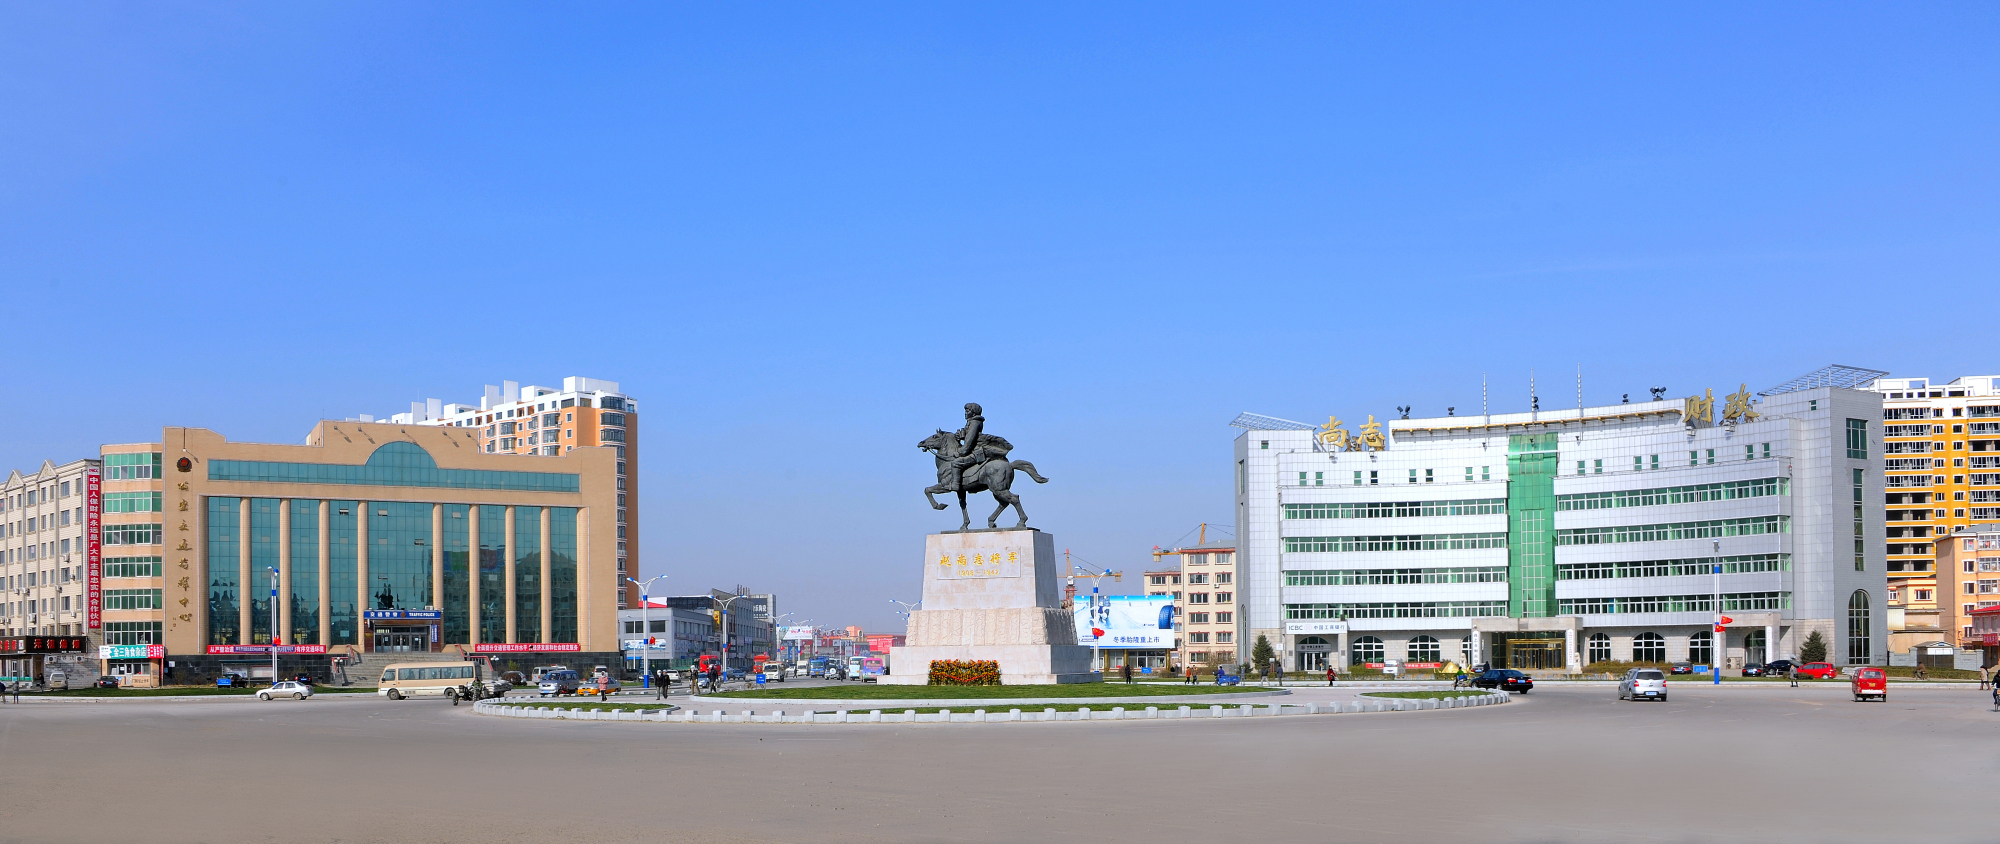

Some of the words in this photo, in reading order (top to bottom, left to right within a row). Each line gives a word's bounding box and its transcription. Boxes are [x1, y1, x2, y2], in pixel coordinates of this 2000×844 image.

[1318, 414, 1385, 447] 尚志
[1684, 383, 1760, 423] 财政
[939, 551, 1018, 567] 赵尚志将军
[1113, 636, 1160, 644] 冬季胎隆重上市
